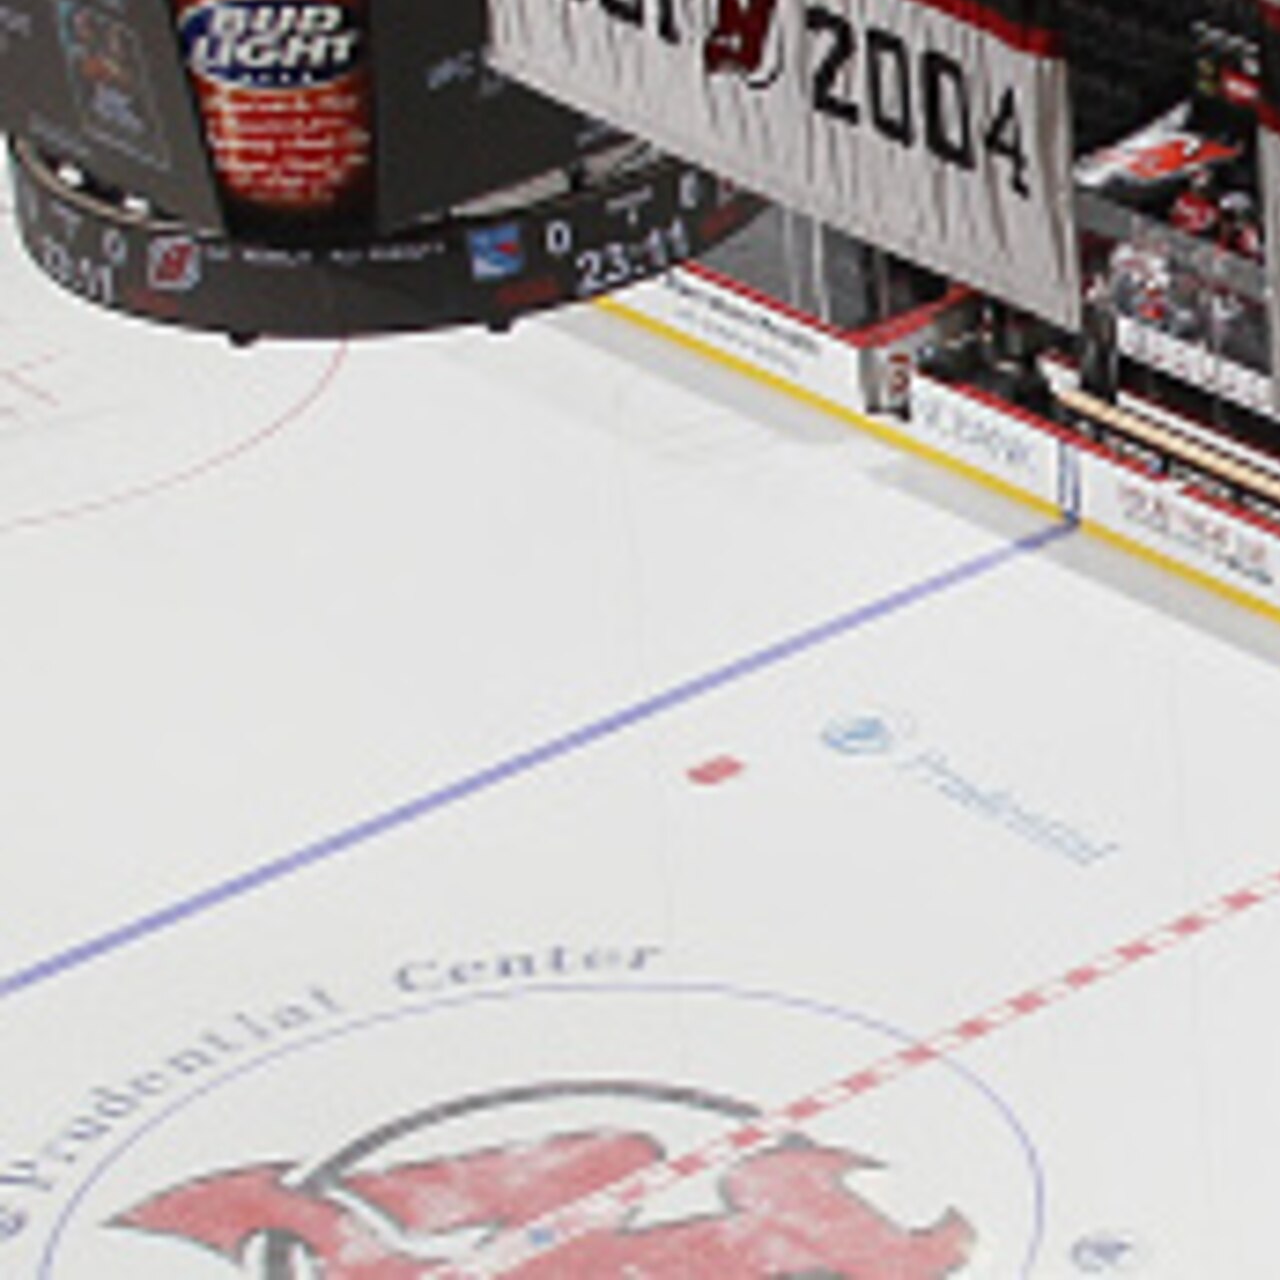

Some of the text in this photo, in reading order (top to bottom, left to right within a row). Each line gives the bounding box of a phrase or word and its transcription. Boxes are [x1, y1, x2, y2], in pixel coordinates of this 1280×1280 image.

[210, 5, 342, 37] BUD
[191, 30, 360, 70] LIGHT
[804, 5, 1030, 200] 2004
[392, 942, 664, 995] Center
